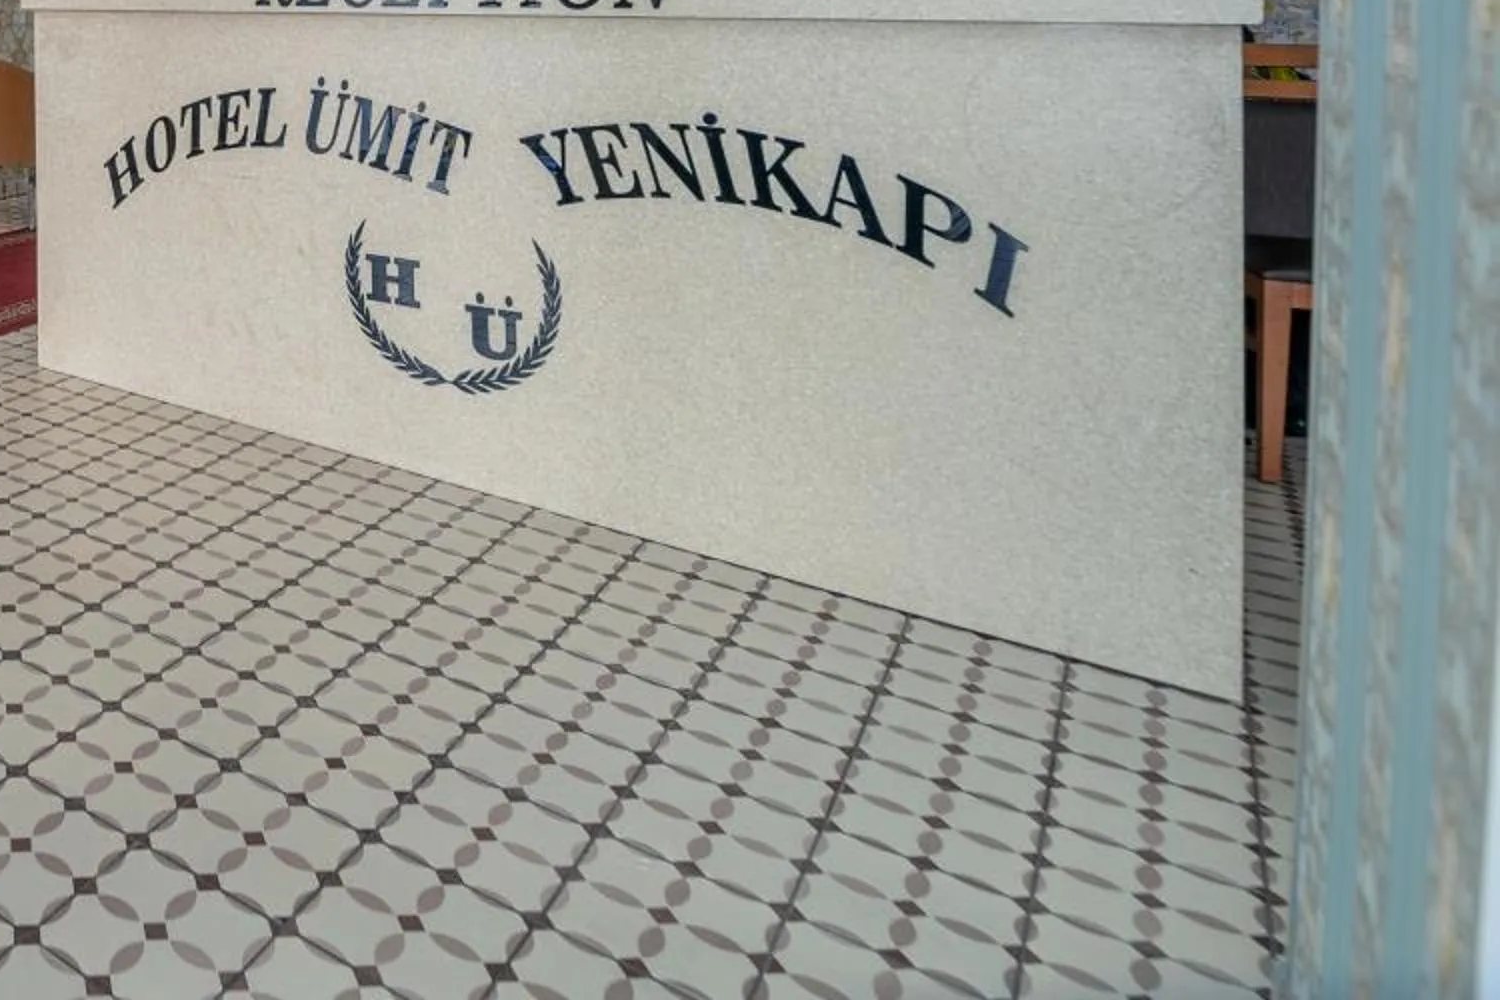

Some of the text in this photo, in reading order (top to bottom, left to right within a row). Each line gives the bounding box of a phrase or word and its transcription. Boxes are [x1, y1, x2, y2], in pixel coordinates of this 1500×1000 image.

[104, 76, 1029, 318] HOTEL ÜMİT YENİKAPI
[366, 253, 420, 309] H
[464, 292, 522, 361] Ü
